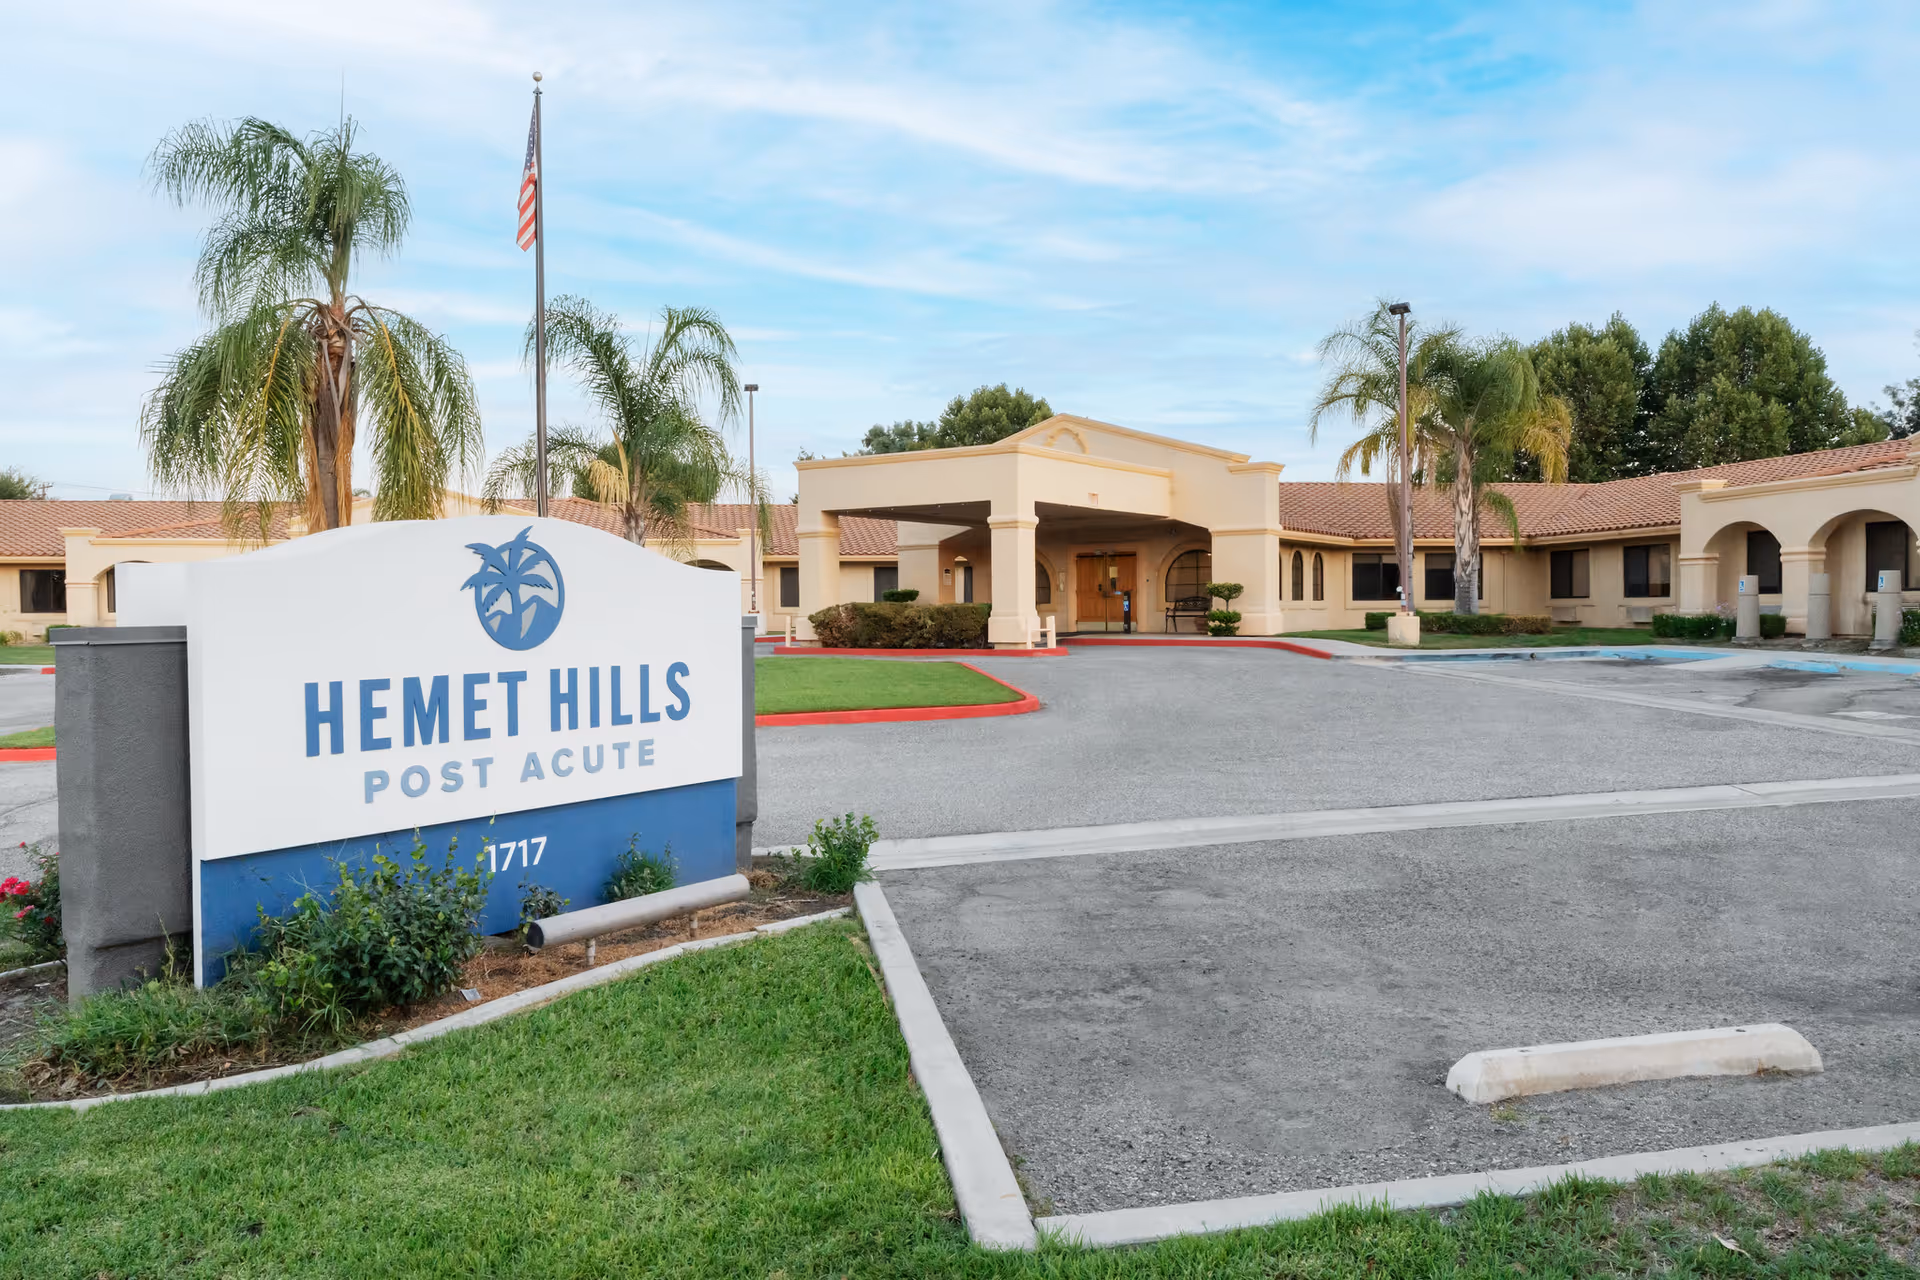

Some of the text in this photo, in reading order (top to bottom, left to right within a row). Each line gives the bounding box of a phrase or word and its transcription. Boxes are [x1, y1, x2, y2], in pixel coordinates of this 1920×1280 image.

[304, 661, 691, 757] HEMET HILLS
[364, 738, 656, 804] POST ACUTE
[488, 836, 548, 873] 1717
